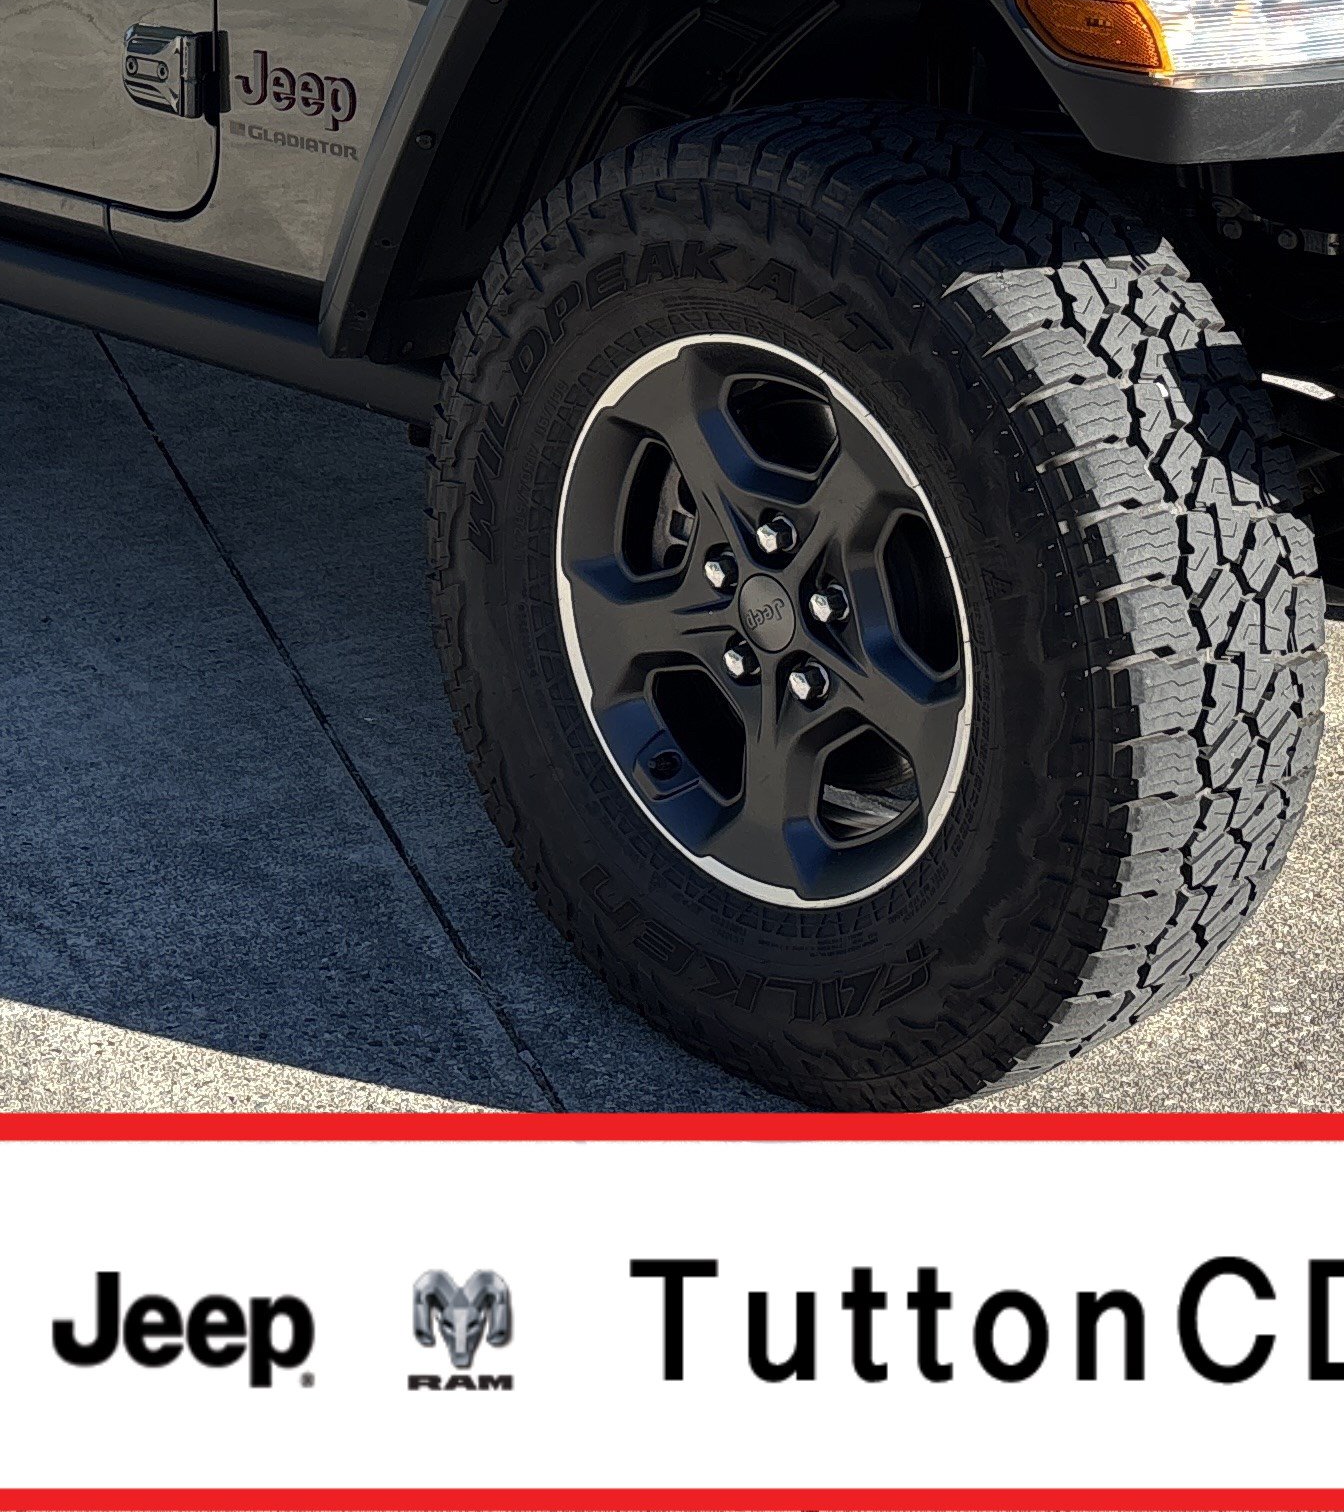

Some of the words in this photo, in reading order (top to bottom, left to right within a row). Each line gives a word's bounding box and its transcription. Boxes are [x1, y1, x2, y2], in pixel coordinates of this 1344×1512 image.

[234, 49, 357, 132] Jeep
[248, 124, 359, 161] GLADIATOR
[466, 240, 738, 564] WILDPEAK
[745, 597, 785, 631] Jeep
